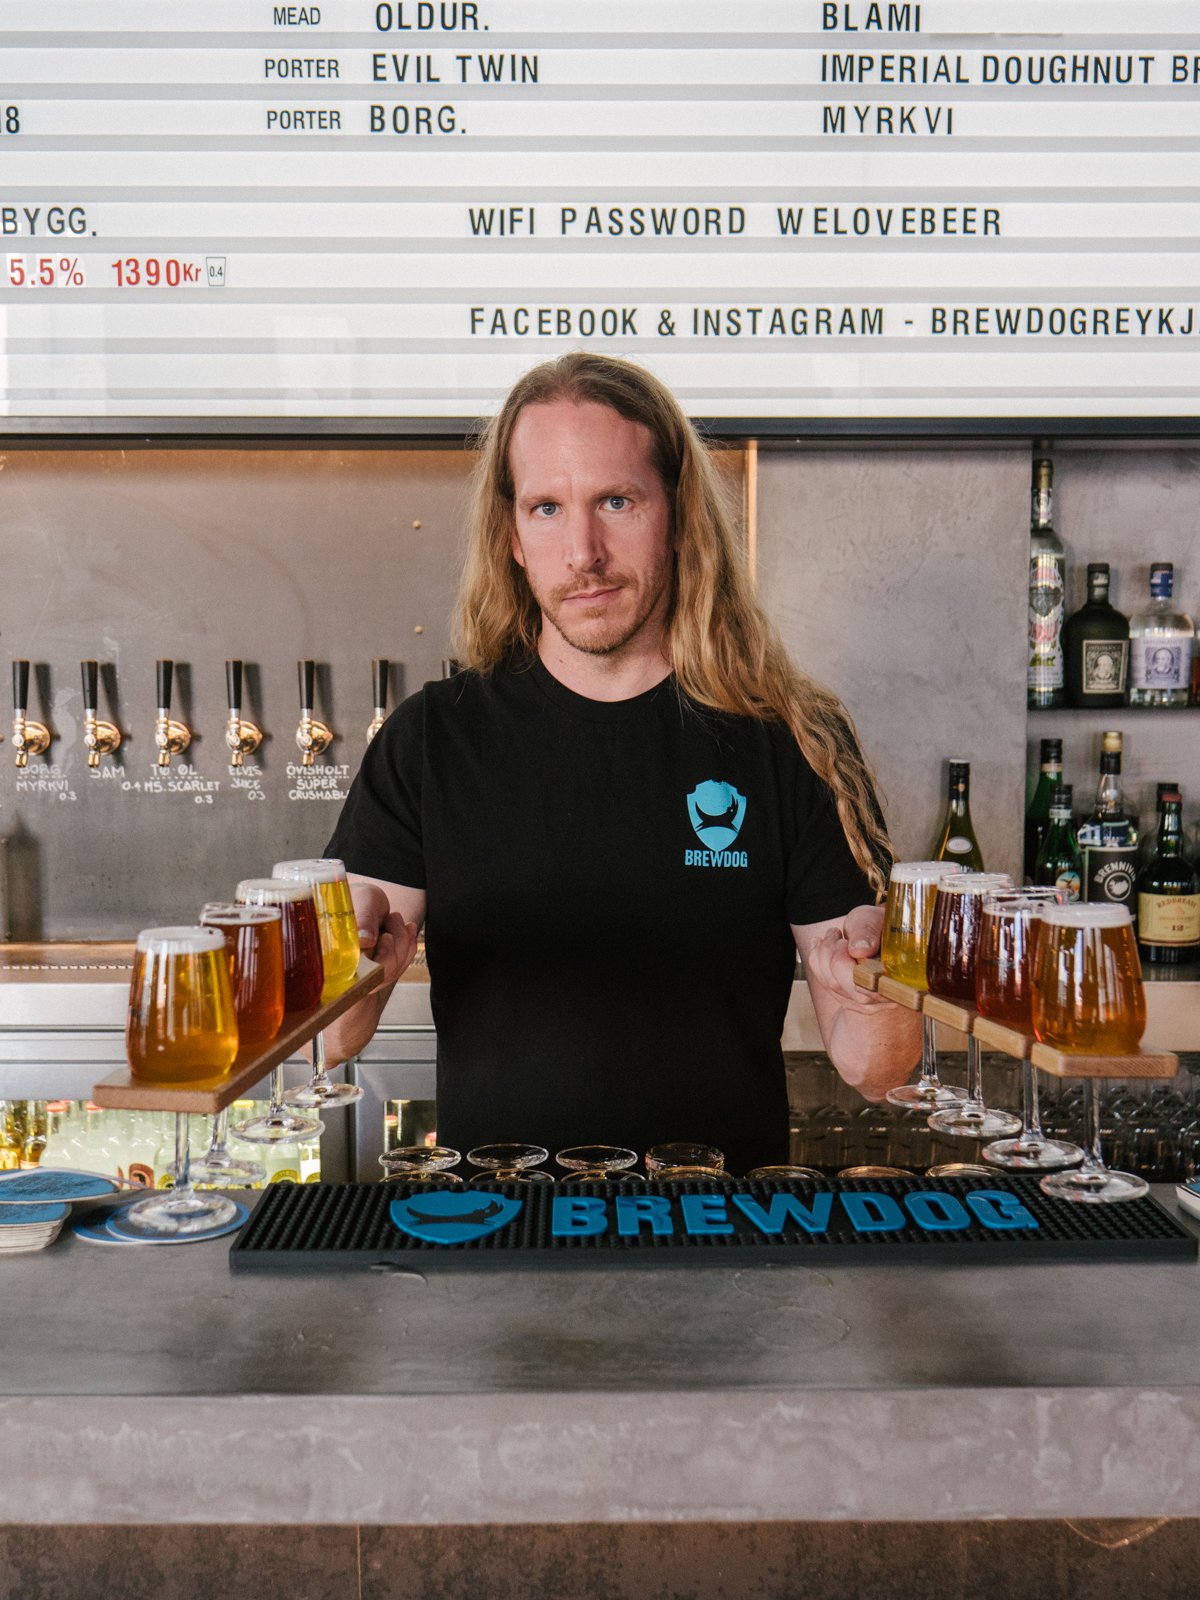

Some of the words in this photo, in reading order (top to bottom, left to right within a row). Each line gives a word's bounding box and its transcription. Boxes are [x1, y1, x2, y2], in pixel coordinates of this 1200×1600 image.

[273, 7, 321, 26] MEAD
[376, 2, 489, 32] OLDUR.
[822, 2, 921, 33] BLAMI
[264, 58, 340, 79] PORTER
[372, 53, 441, 83] EVIL
[456, 54, 539, 83] TWIN
[821, 54, 970, 84] IMPERIAL
[982, 55, 1155, 84] DOUGHNUT
[267, 109, 341, 130] PORTER
[370, 105, 466, 134] BORG.
[823, 106, 953, 135] MYRKVI
[1, 207, 97, 236] BYGG.
[469, 207, 535, 236] WIFI
[561, 207, 746, 236] PASSWORD
[776, 207, 1001, 236] WELOVEBEER
[10, 258, 84, 286] 5.5%
[209, 265, 223, 278] 0.4
[470, 308, 638, 336] FACEBOOK
[658, 309, 676, 336] &
[693, 308, 884, 336] INSTAGRAM
[296, 778, 338, 790] SUPER
[684, 849, 748, 868] BREWDOG
[552, 1189, 1040, 1237] BREWDOG
